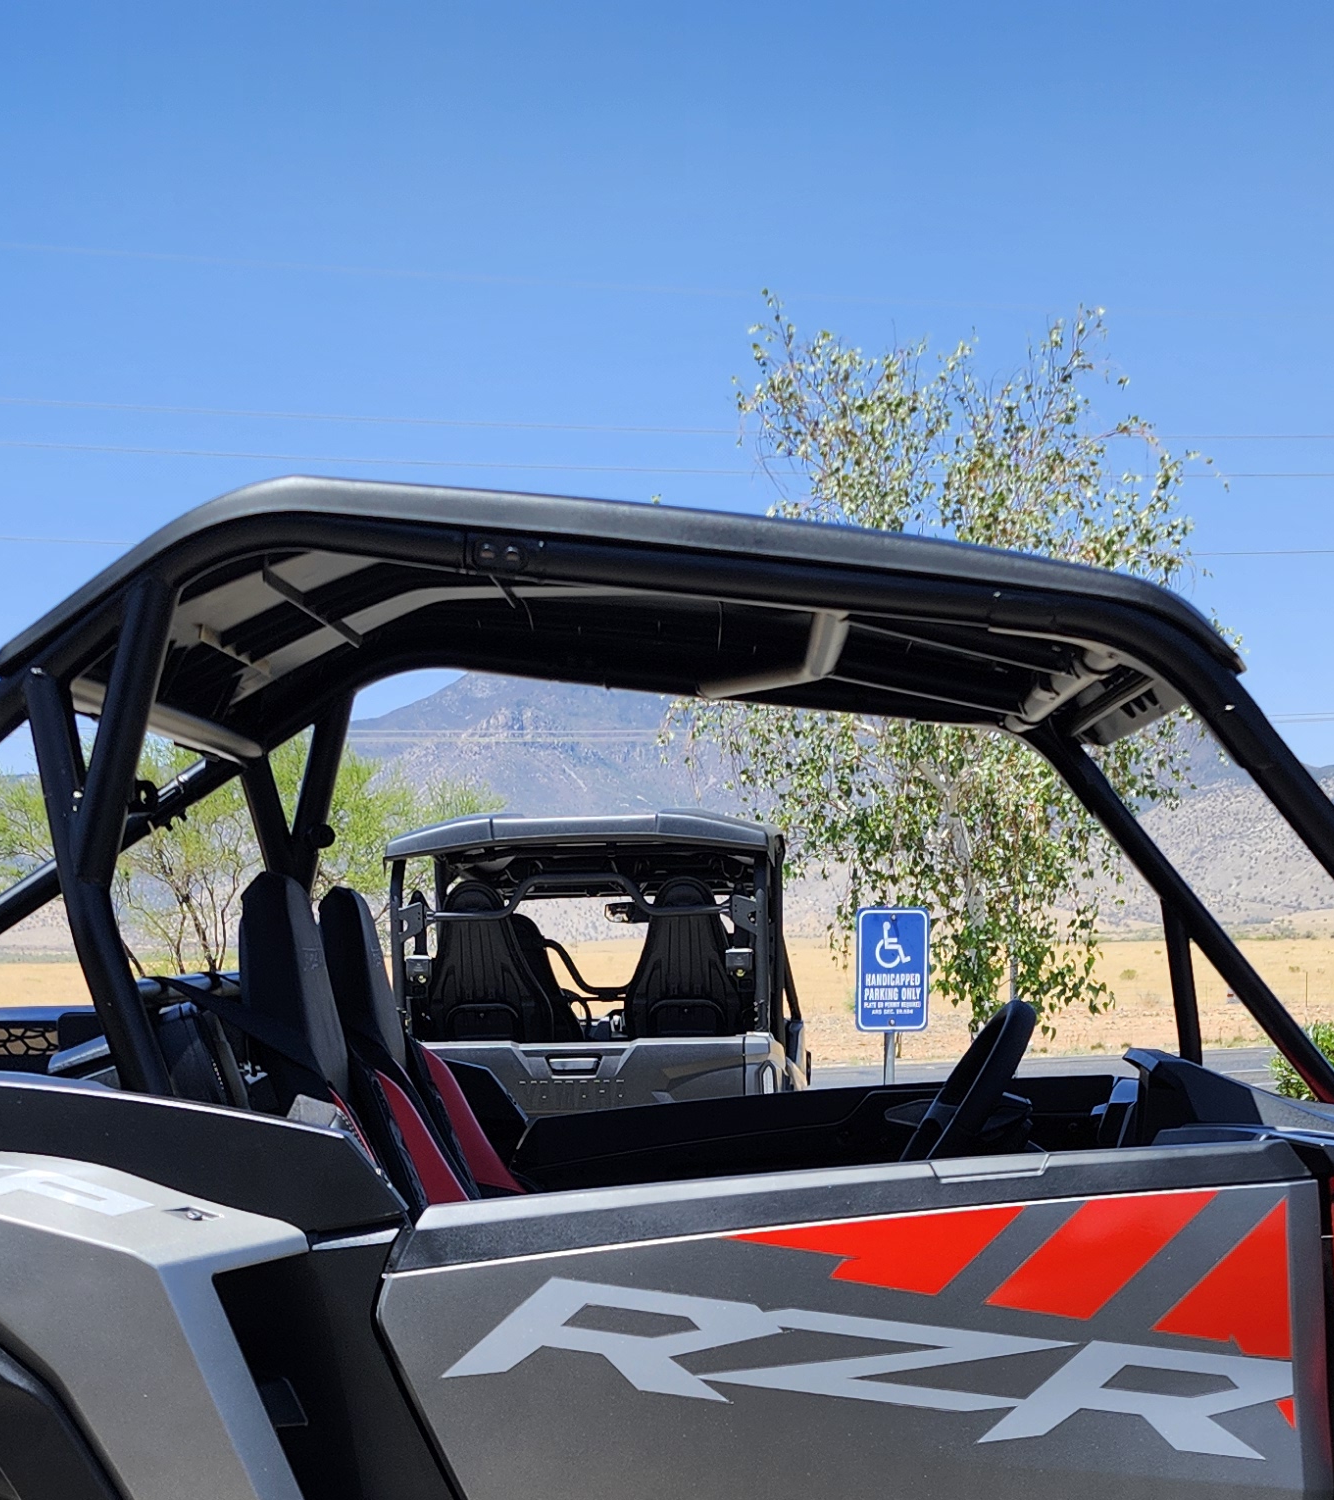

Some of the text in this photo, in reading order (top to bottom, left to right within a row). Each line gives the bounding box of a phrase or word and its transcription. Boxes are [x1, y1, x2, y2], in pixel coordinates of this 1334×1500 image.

[865, 973, 921, 986] HANDICAPPED
[864, 987, 922, 1001] PARKING ONLY
[442, 1277, 1294, 1460] RZR
